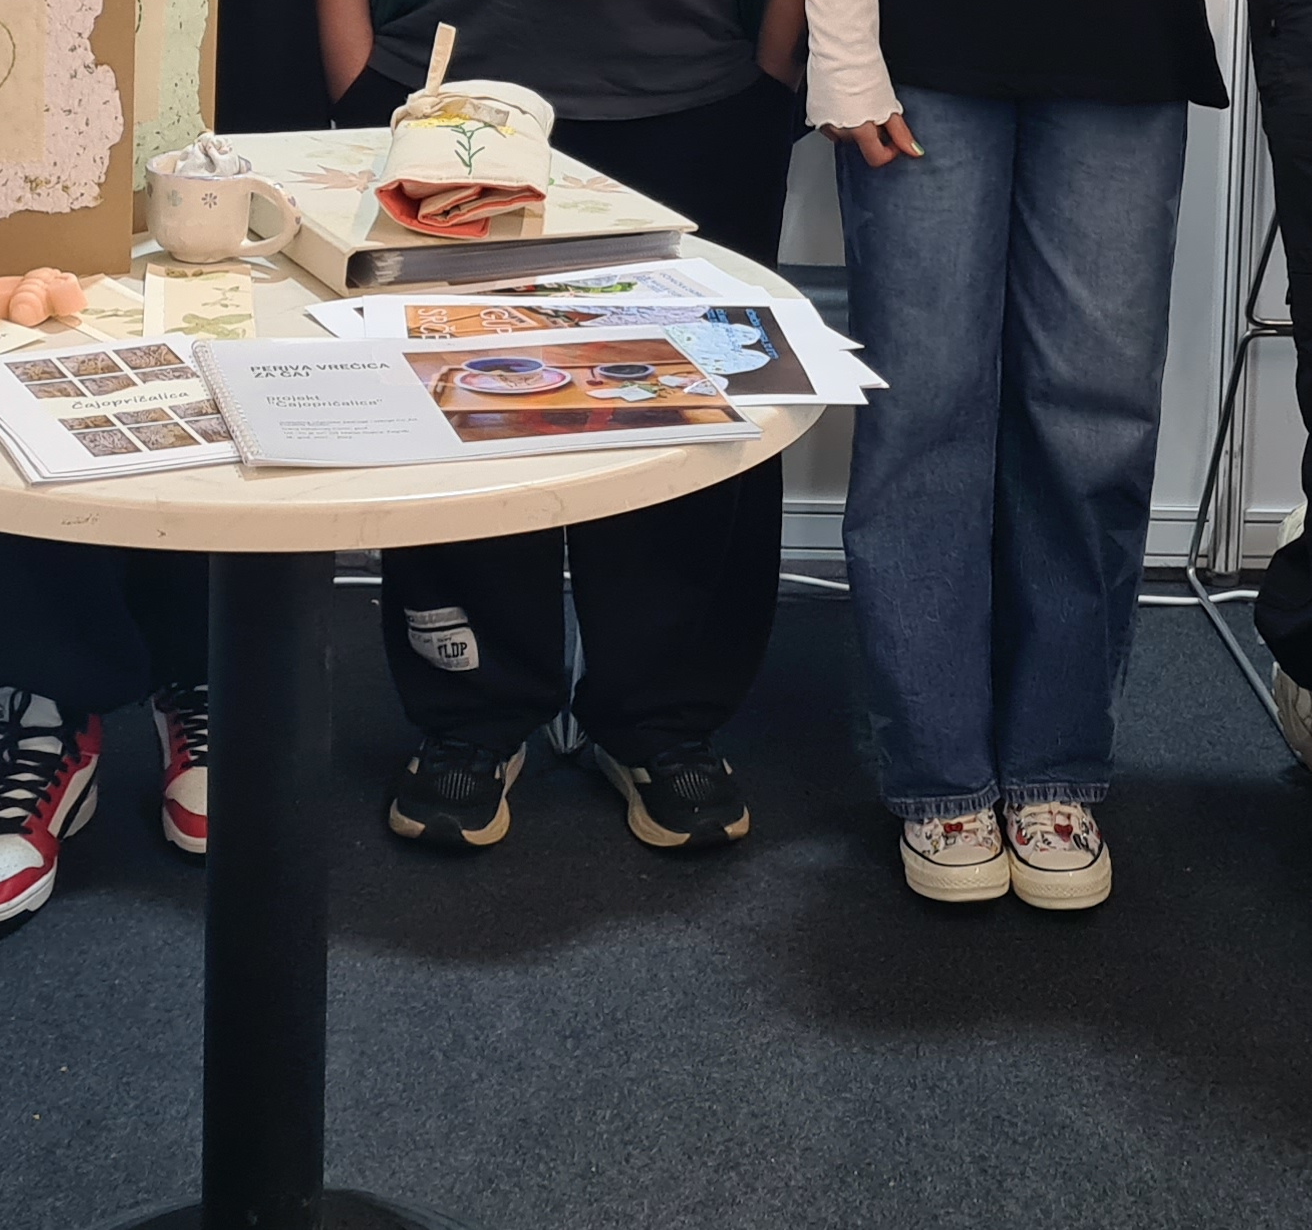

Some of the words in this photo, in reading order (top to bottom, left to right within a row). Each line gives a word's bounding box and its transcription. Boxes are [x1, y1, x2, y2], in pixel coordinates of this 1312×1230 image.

[250, 364, 313, 372] PERIVA
[316, 363, 390, 371] VREČICA
[266, 395, 320, 404] projekt
